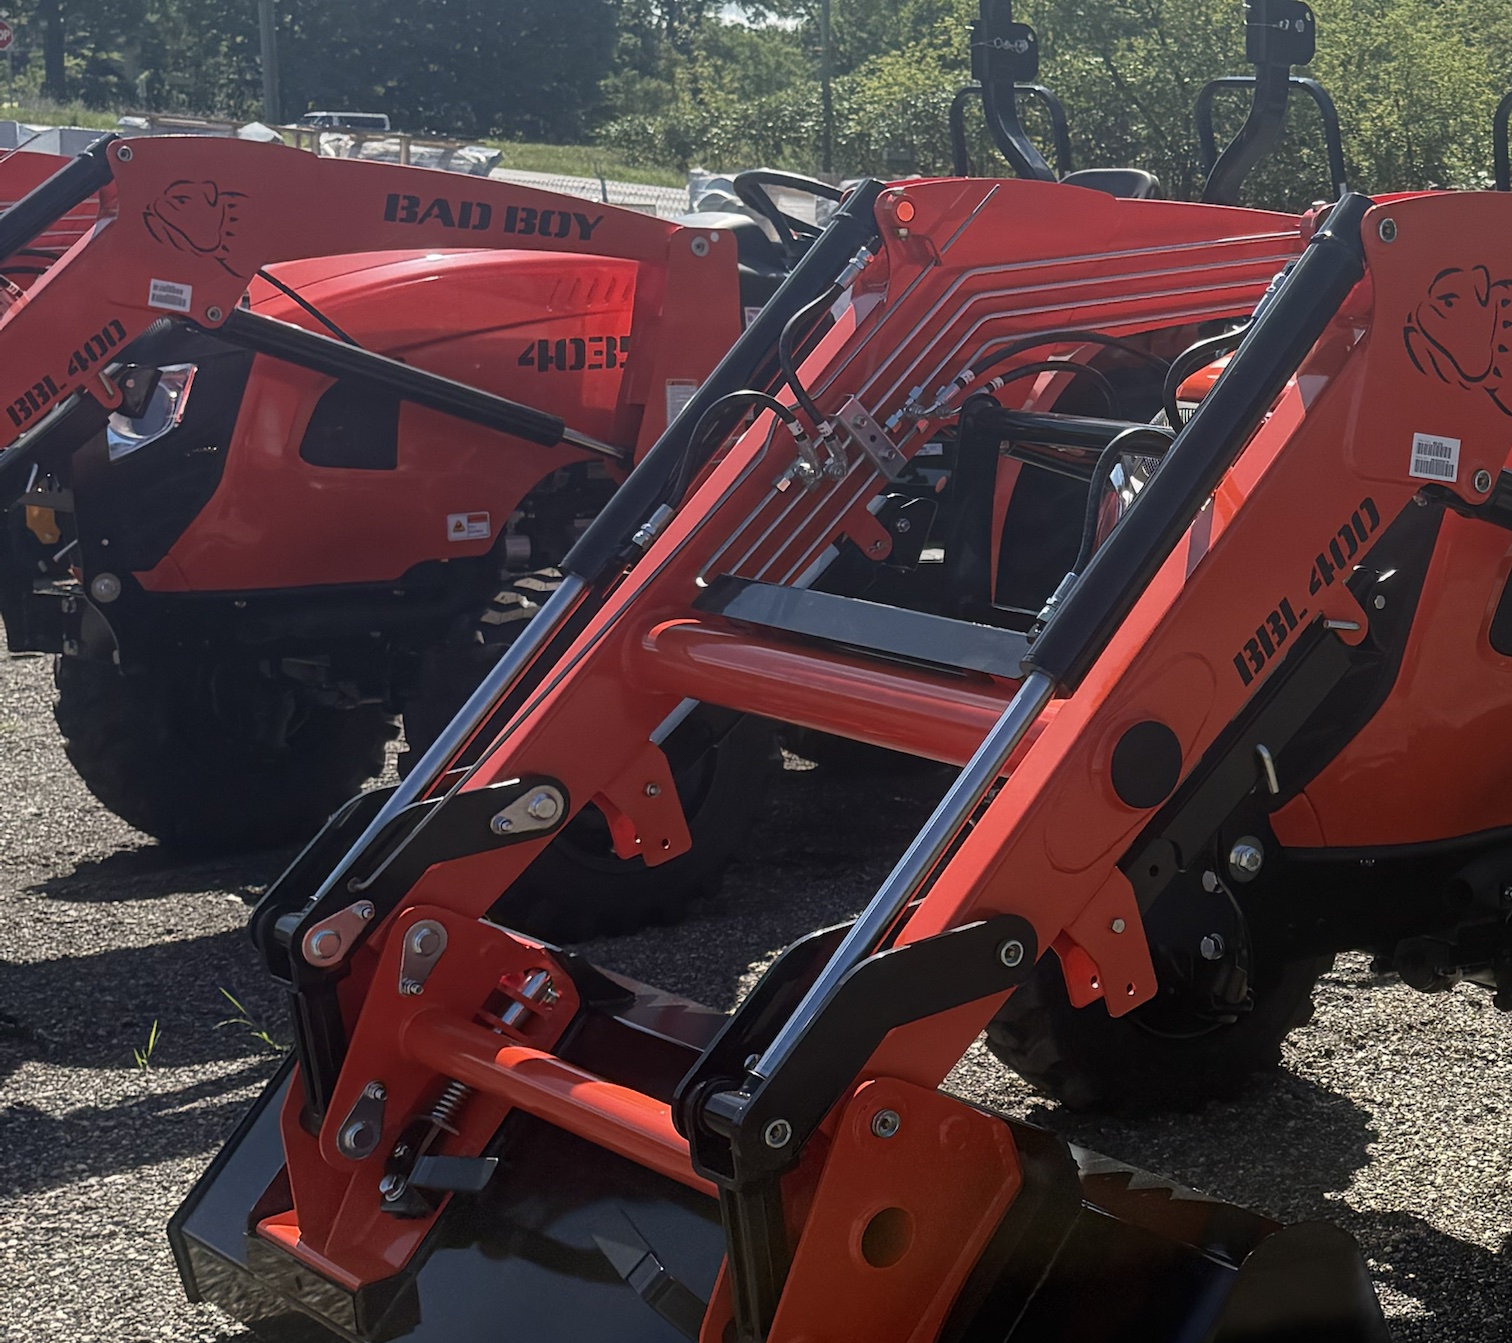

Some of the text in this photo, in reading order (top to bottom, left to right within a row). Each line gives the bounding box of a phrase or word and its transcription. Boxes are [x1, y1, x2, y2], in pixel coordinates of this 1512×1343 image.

[384, 193, 604, 241] BAD BOY
[6, 319, 127, 427] BBL 400
[1233, 497, 1381, 687] BBL 400
